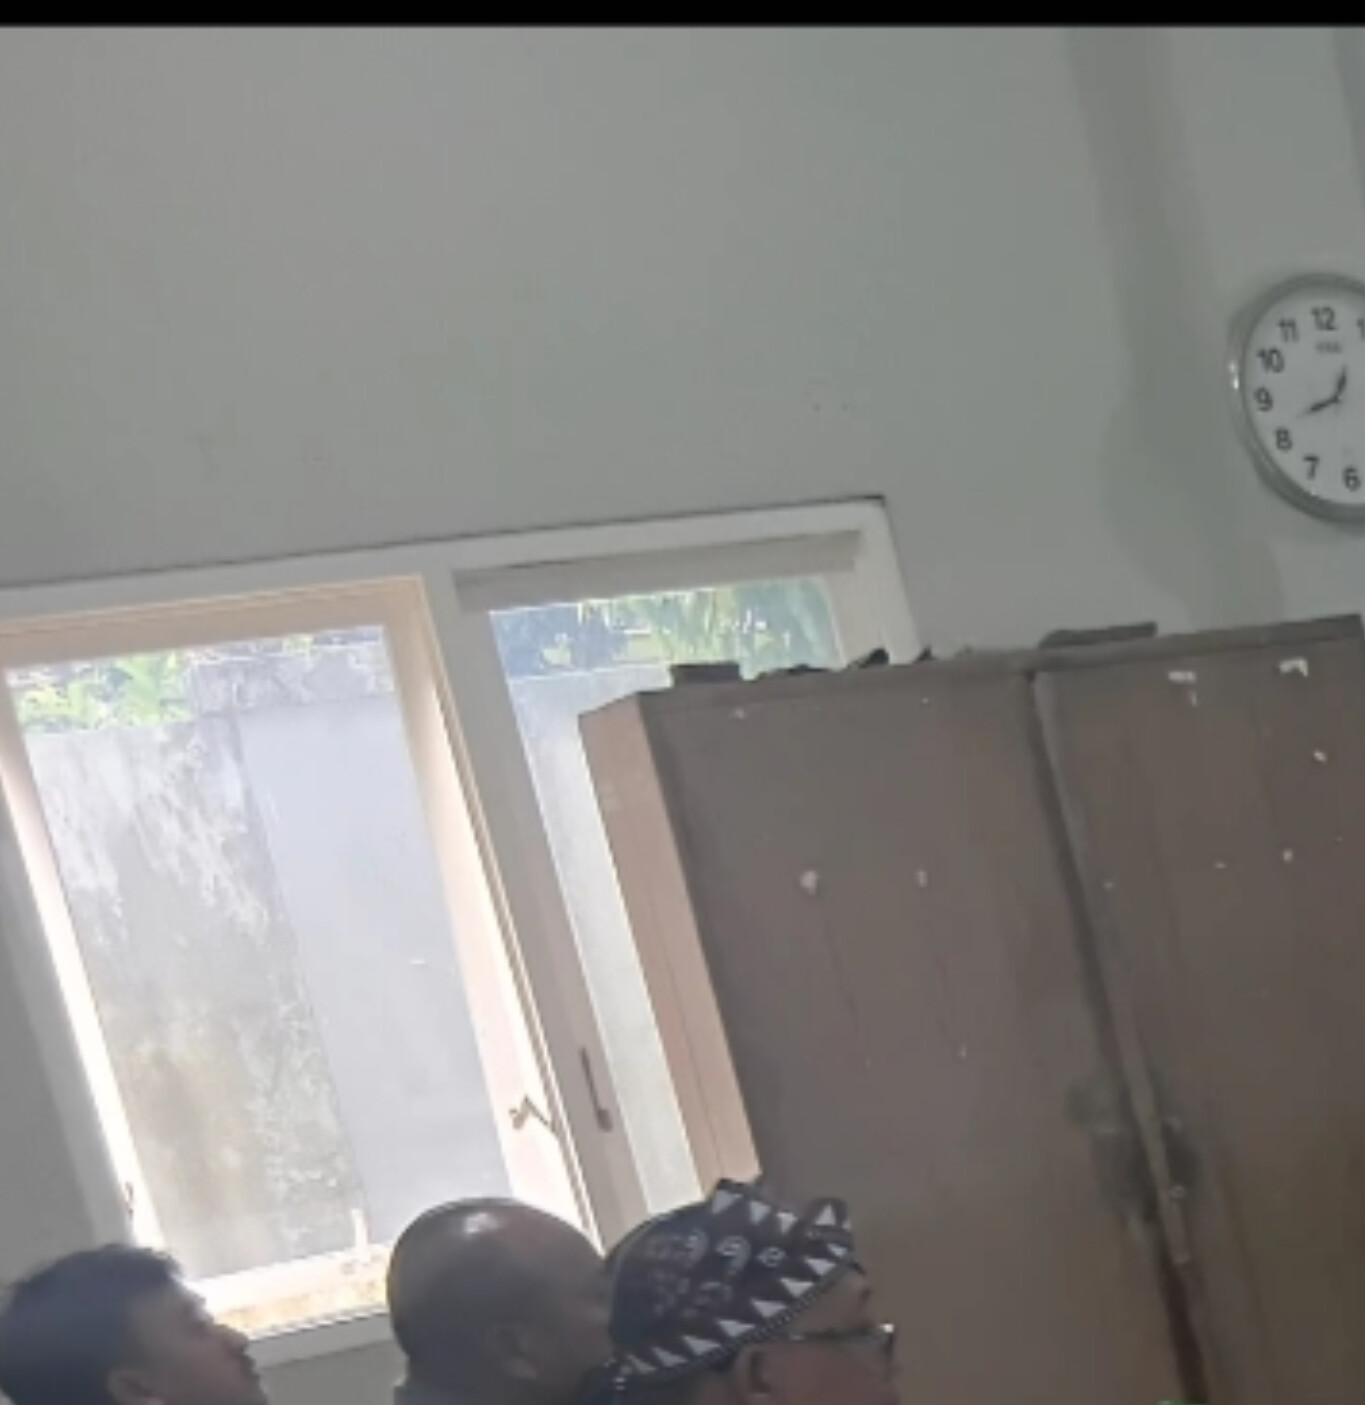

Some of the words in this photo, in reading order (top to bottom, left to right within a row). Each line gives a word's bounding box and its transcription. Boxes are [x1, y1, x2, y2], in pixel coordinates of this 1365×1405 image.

[1277, 318, 1299, 342] 11
[1311, 306, 1338, 331] 12
[1257, 348, 1285, 373] 10
[1254, 387, 1274, 412] 9
[1275, 427, 1293, 451] 8
[1303, 455, 1320, 479] 7
[1343, 467, 1361, 491] 6
